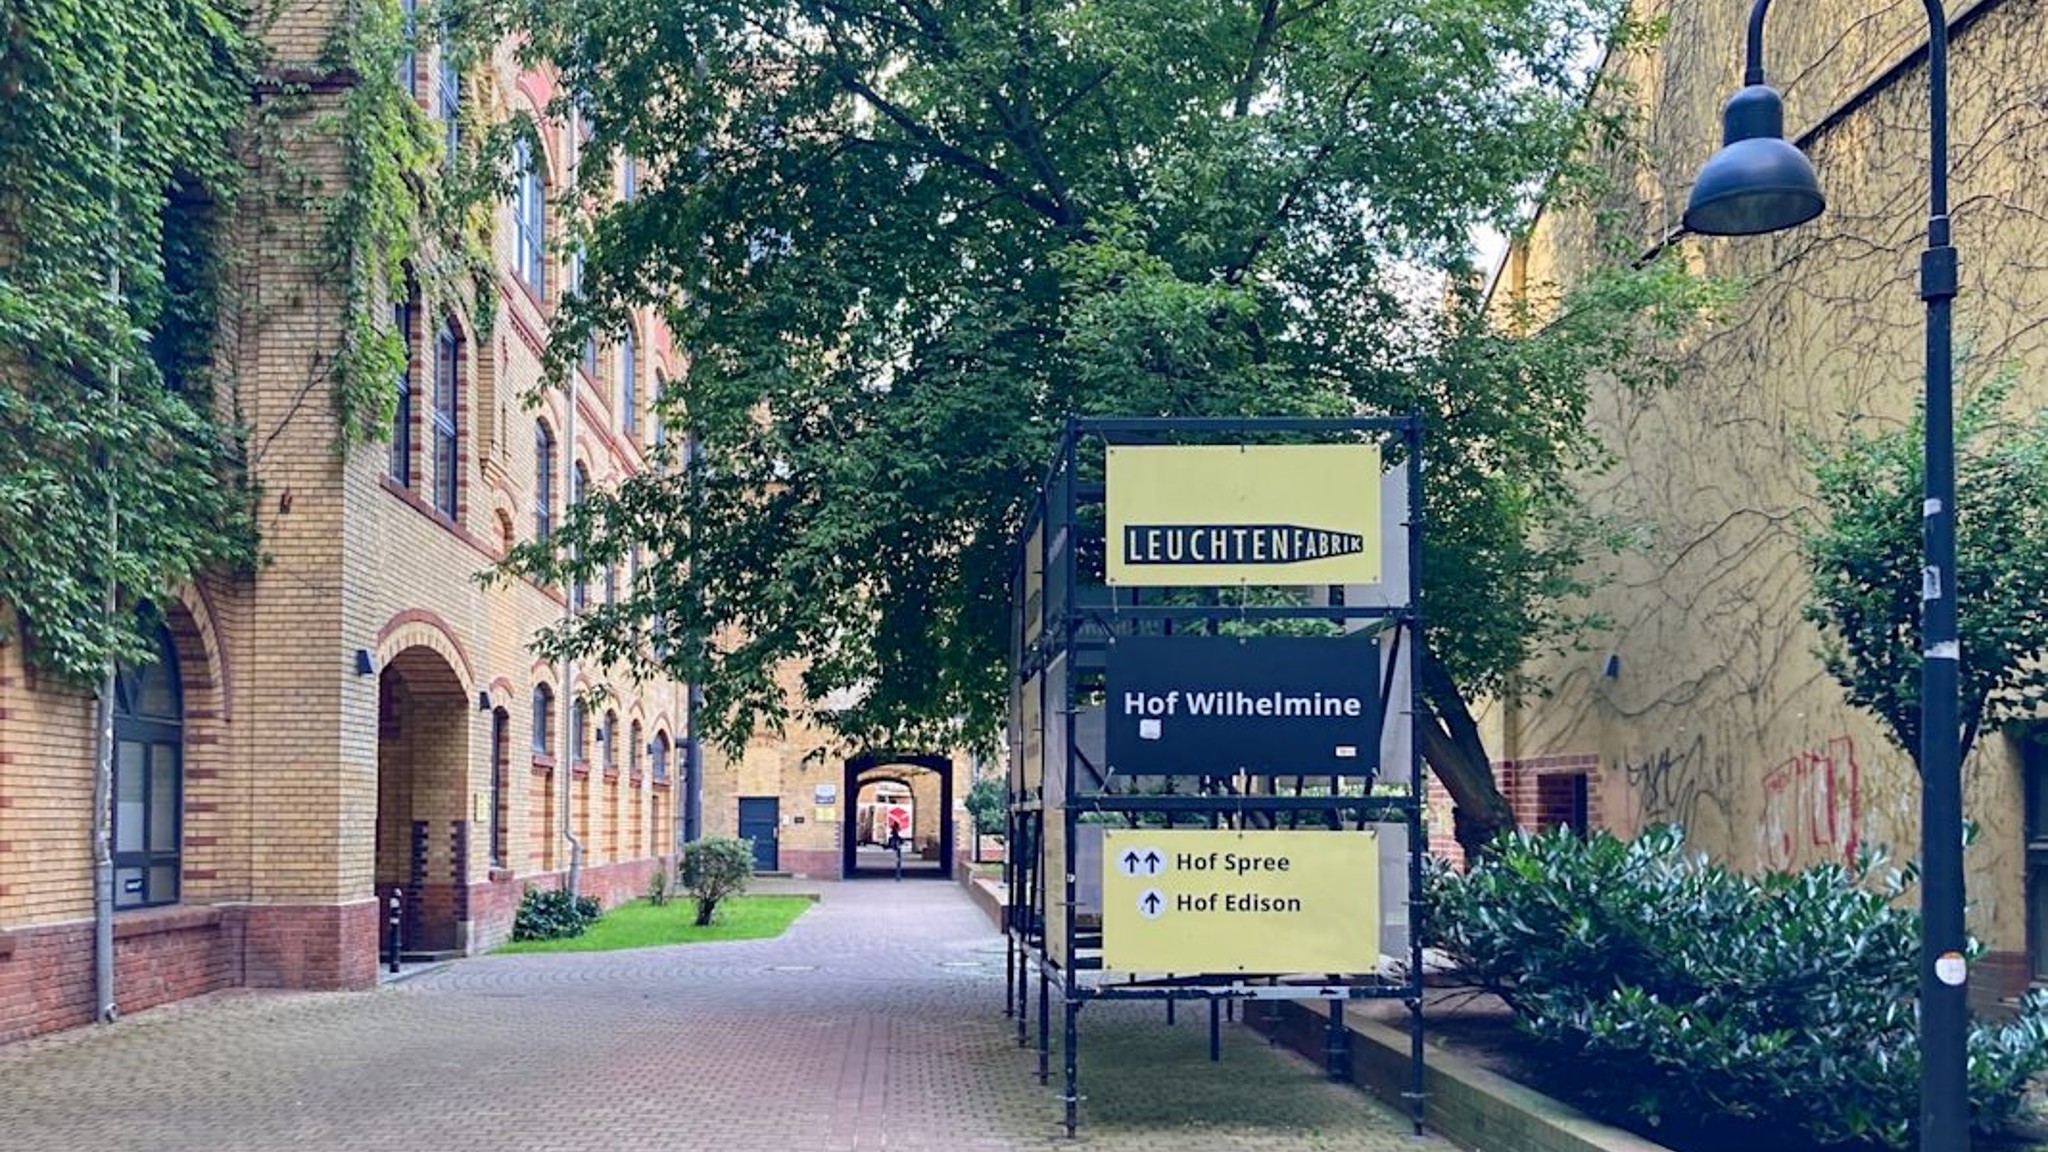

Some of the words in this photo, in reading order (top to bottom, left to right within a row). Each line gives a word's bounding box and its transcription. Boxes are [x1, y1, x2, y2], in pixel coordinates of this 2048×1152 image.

[1129, 529, 1362, 561] LEUCHTENFABRIK
[1124, 691, 1179, 716] Hof
[1186, 691, 1362, 717] Wilhelmine
[1176, 853, 1219, 871] Hof
[1225, 853, 1290, 875] Spree
[1176, 893, 1219, 912] Hof
[1225, 893, 1302, 912] Edison
